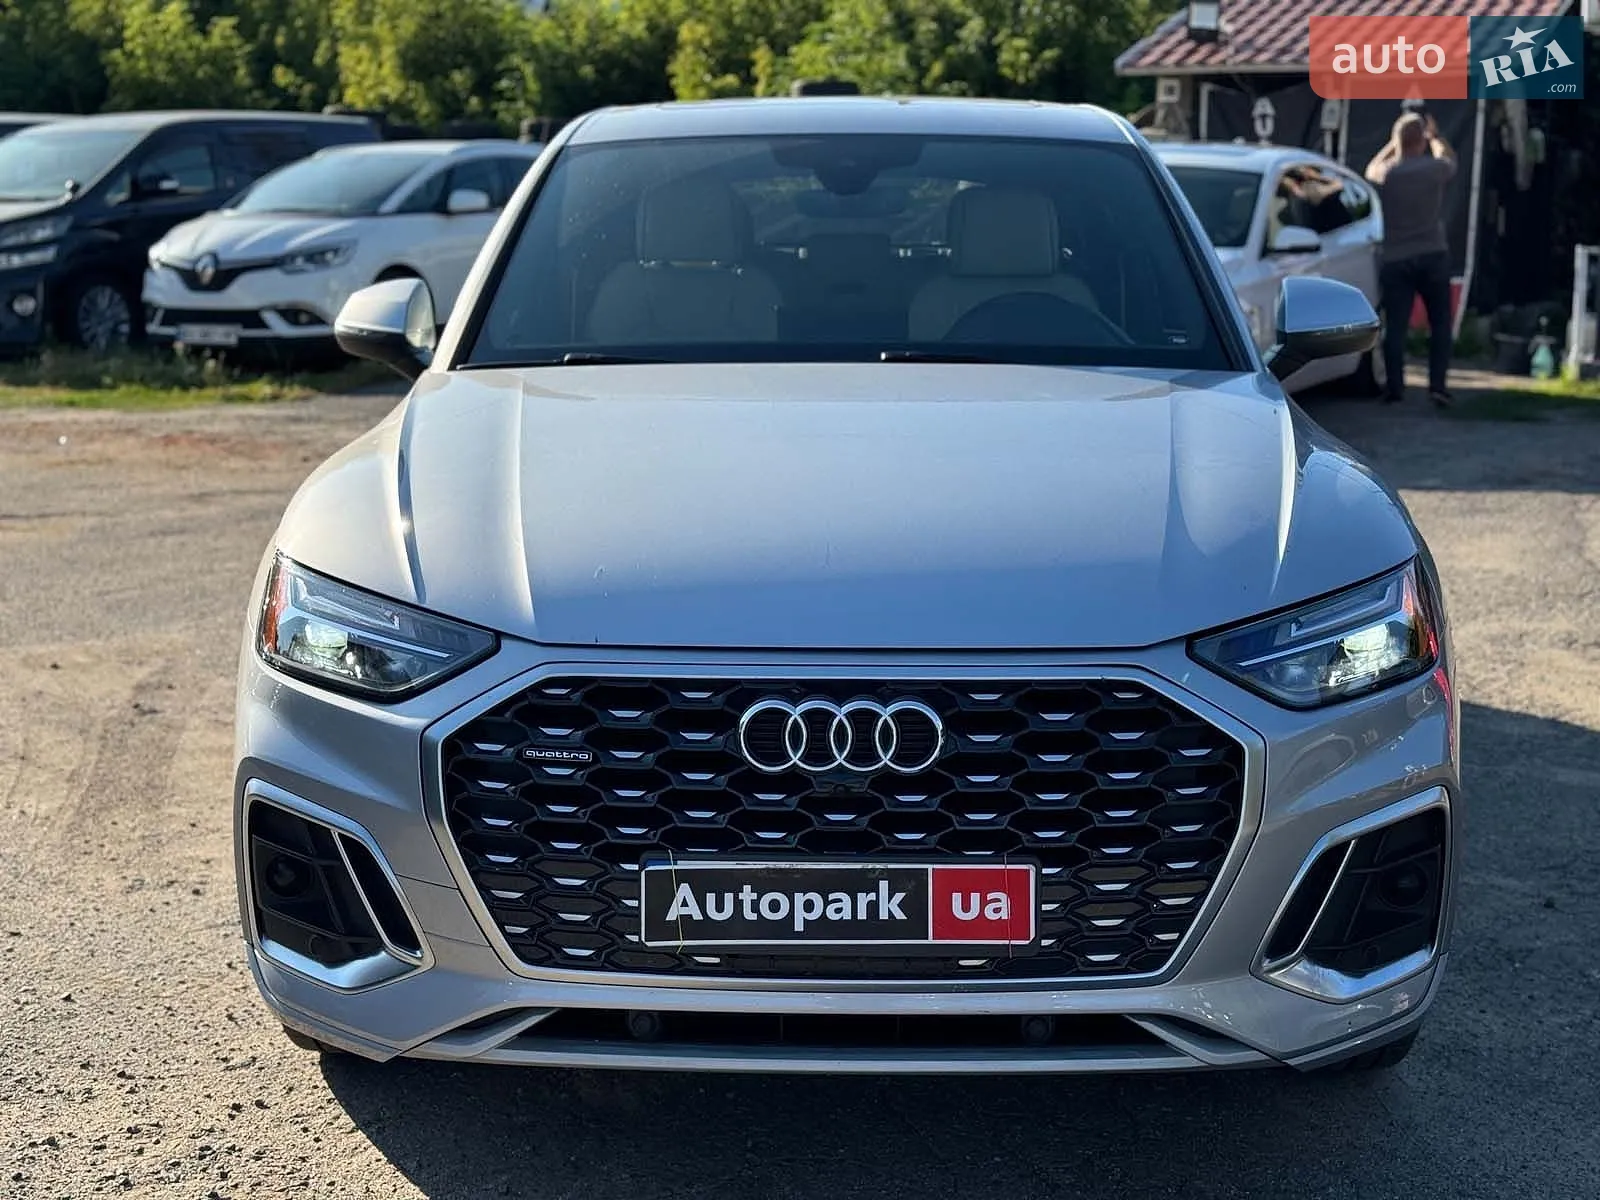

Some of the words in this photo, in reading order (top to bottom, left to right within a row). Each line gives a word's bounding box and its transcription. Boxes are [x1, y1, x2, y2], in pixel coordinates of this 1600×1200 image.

[525, 750, 589, 760] quattro
[665, 880, 908, 932] Autopark
[951, 891, 1011, 921] ua
